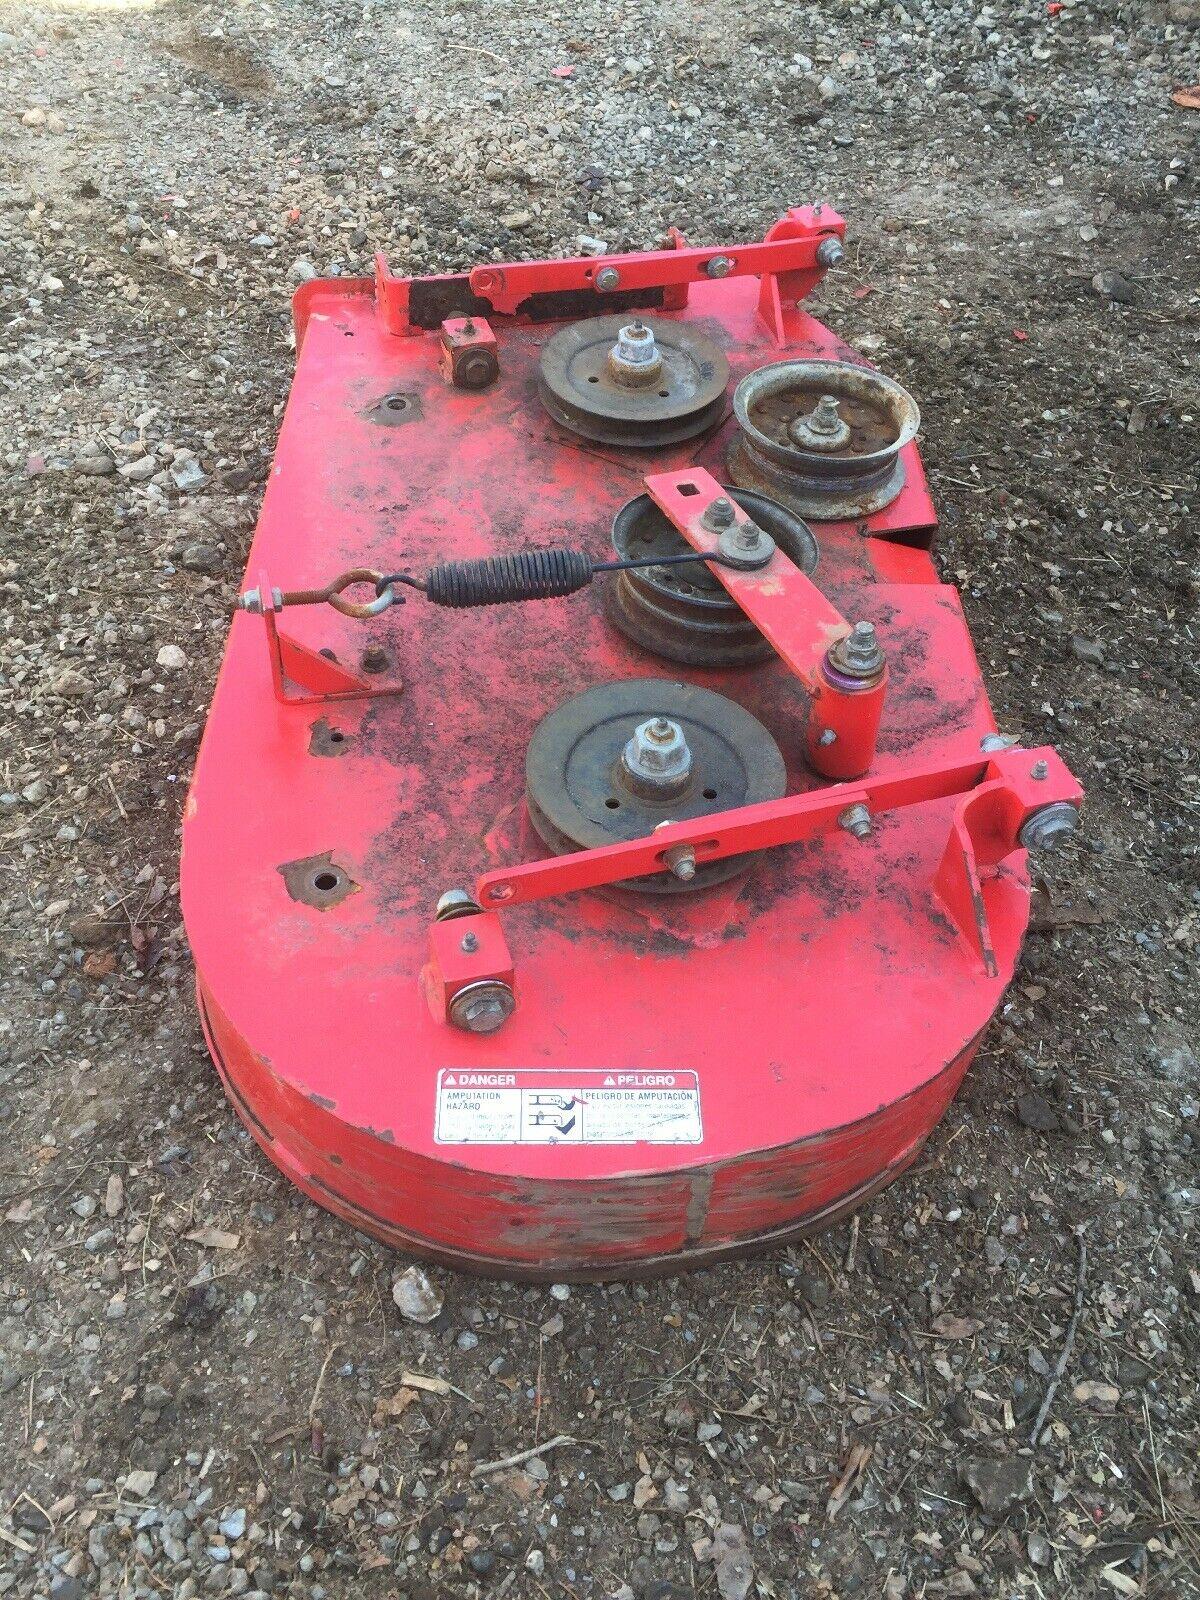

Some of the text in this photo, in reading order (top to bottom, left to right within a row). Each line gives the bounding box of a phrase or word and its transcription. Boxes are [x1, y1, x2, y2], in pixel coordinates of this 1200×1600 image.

[458, 1074, 516, 1086] DANGER
[617, 1075, 676, 1086] PELIGRO
[447, 1092, 501, 1100] AMPUTATION
[585, 1091, 693, 1100] PELIGRO DE AMPUTACIÓN
[446, 1102, 481, 1111] HAZARD
